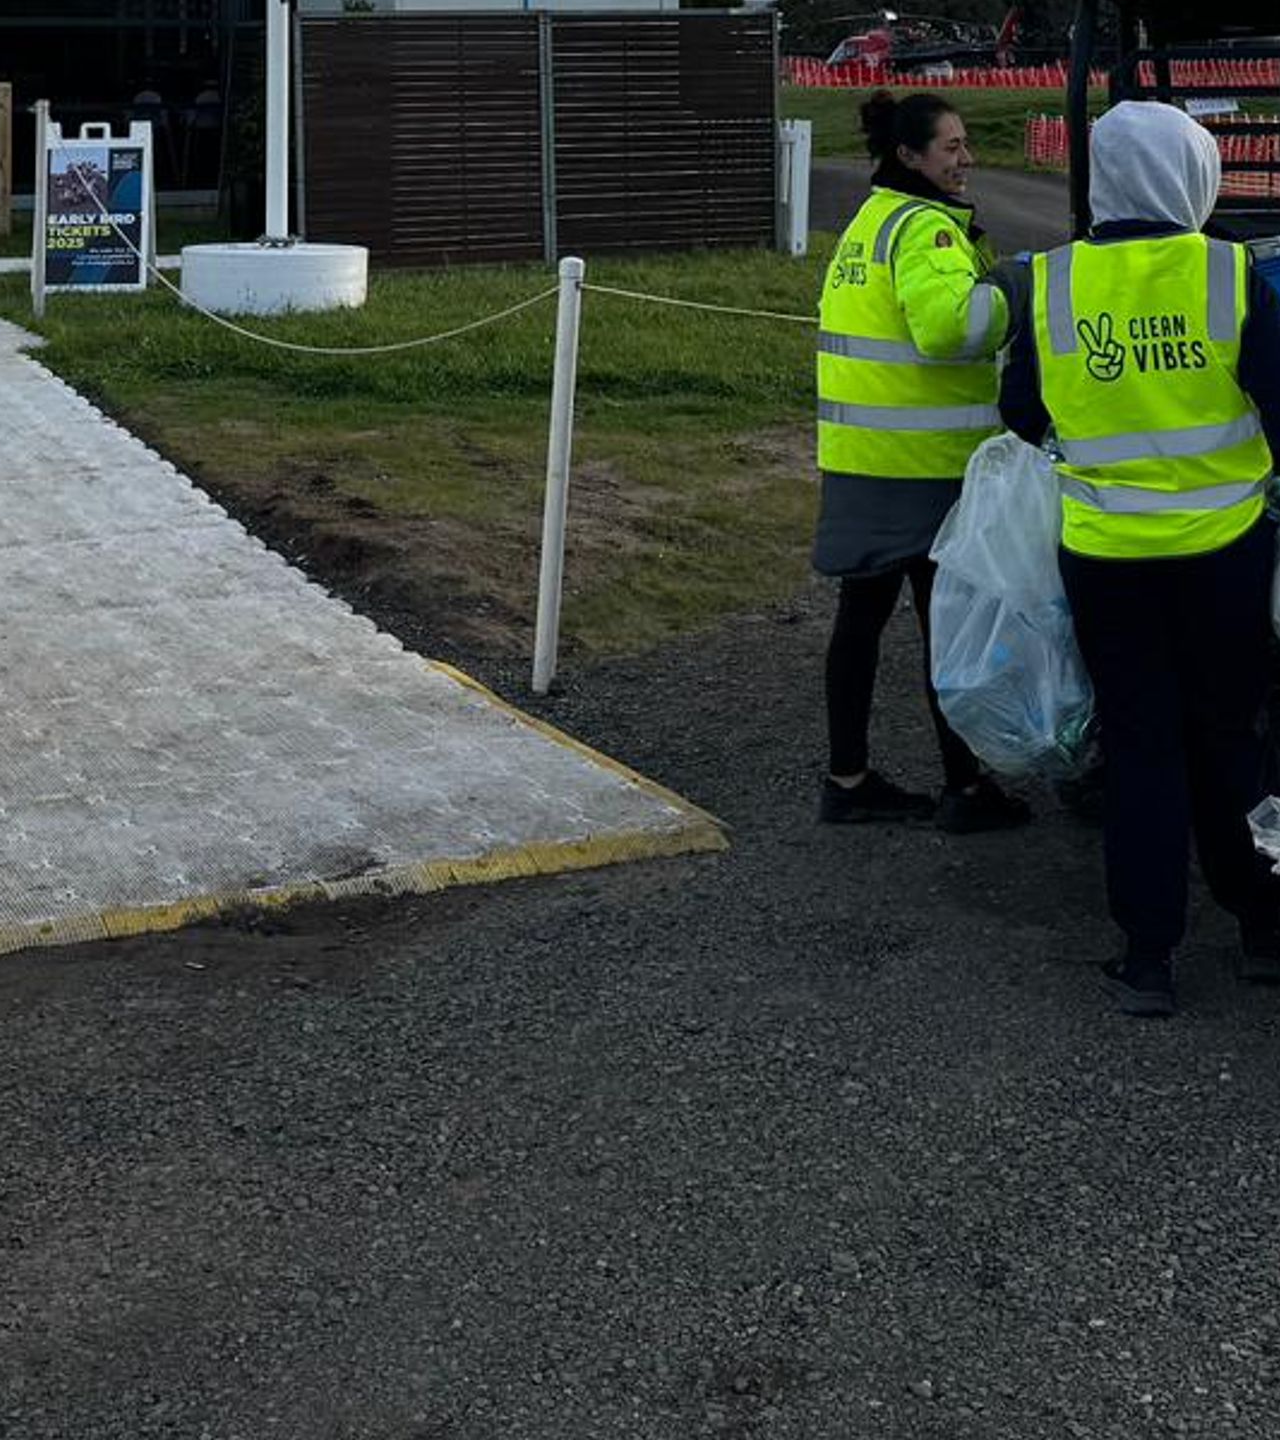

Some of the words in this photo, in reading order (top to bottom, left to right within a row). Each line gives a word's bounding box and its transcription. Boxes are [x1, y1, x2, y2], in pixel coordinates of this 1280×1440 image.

[47, 213, 96, 224] EARLY
[47, 225, 111, 236] TICKETS
[47, 238, 85, 249] 2025
[1129, 314, 1186, 339] CLEAN
[1132, 340, 1207, 372] VIBES
